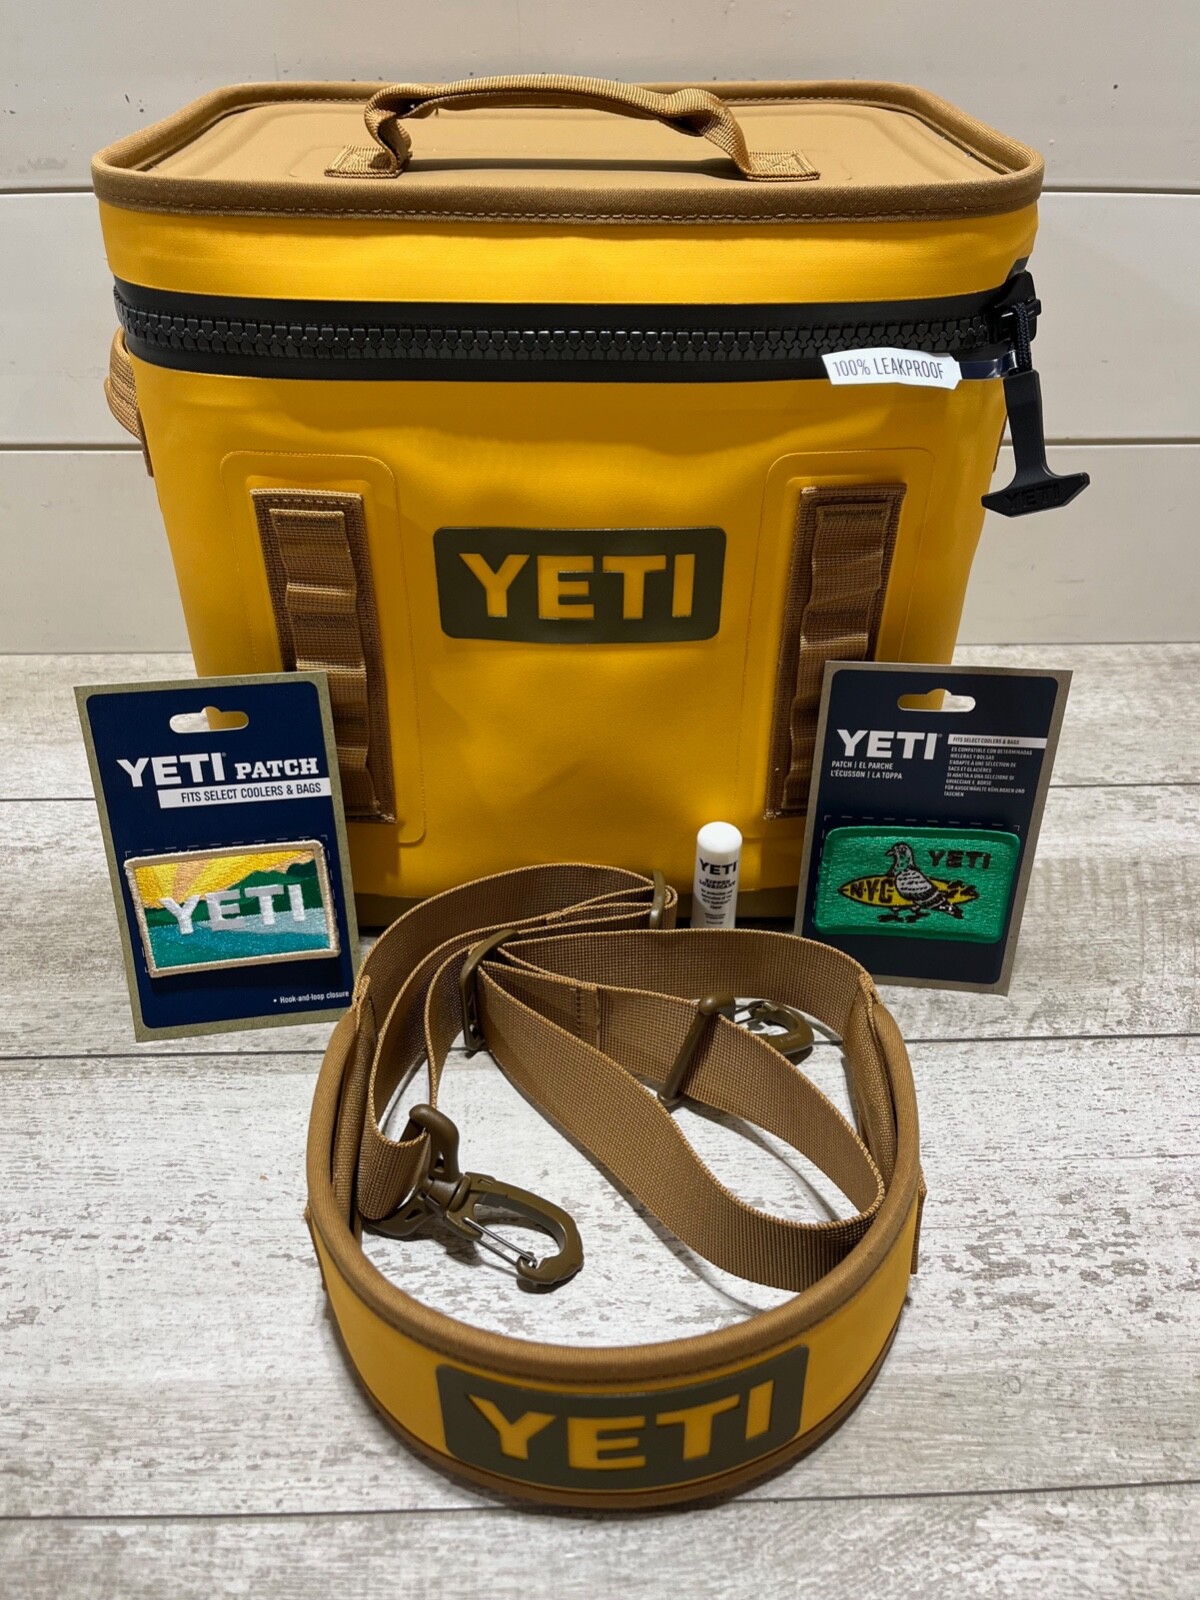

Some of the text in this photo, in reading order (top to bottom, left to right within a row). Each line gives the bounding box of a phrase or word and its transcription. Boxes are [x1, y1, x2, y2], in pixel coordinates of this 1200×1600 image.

[832, 357, 943, 379] 100% LEAKPROOF
[1004, 483, 1060, 511] YETI
[458, 553, 696, 620] YETI
[837, 729, 938, 760] YETI
[116, 752, 319, 788] YETI PATCH
[830, 769, 865, 778] L'ÉCUSSON
[831, 760, 852, 768] PATCH
[859, 761, 866, 769] EL
[868, 762, 893, 770] PARCHE
[181, 782, 322, 803] FITS SELECT COOLERS & BAGS
[699, 857, 737, 875] YETI
[928, 849, 992, 869] YETI
[159, 884, 306, 935] YETI
[280, 991, 349, 1004] Hook-and-loop closure
[467, 1379, 774, 1470] YETI
